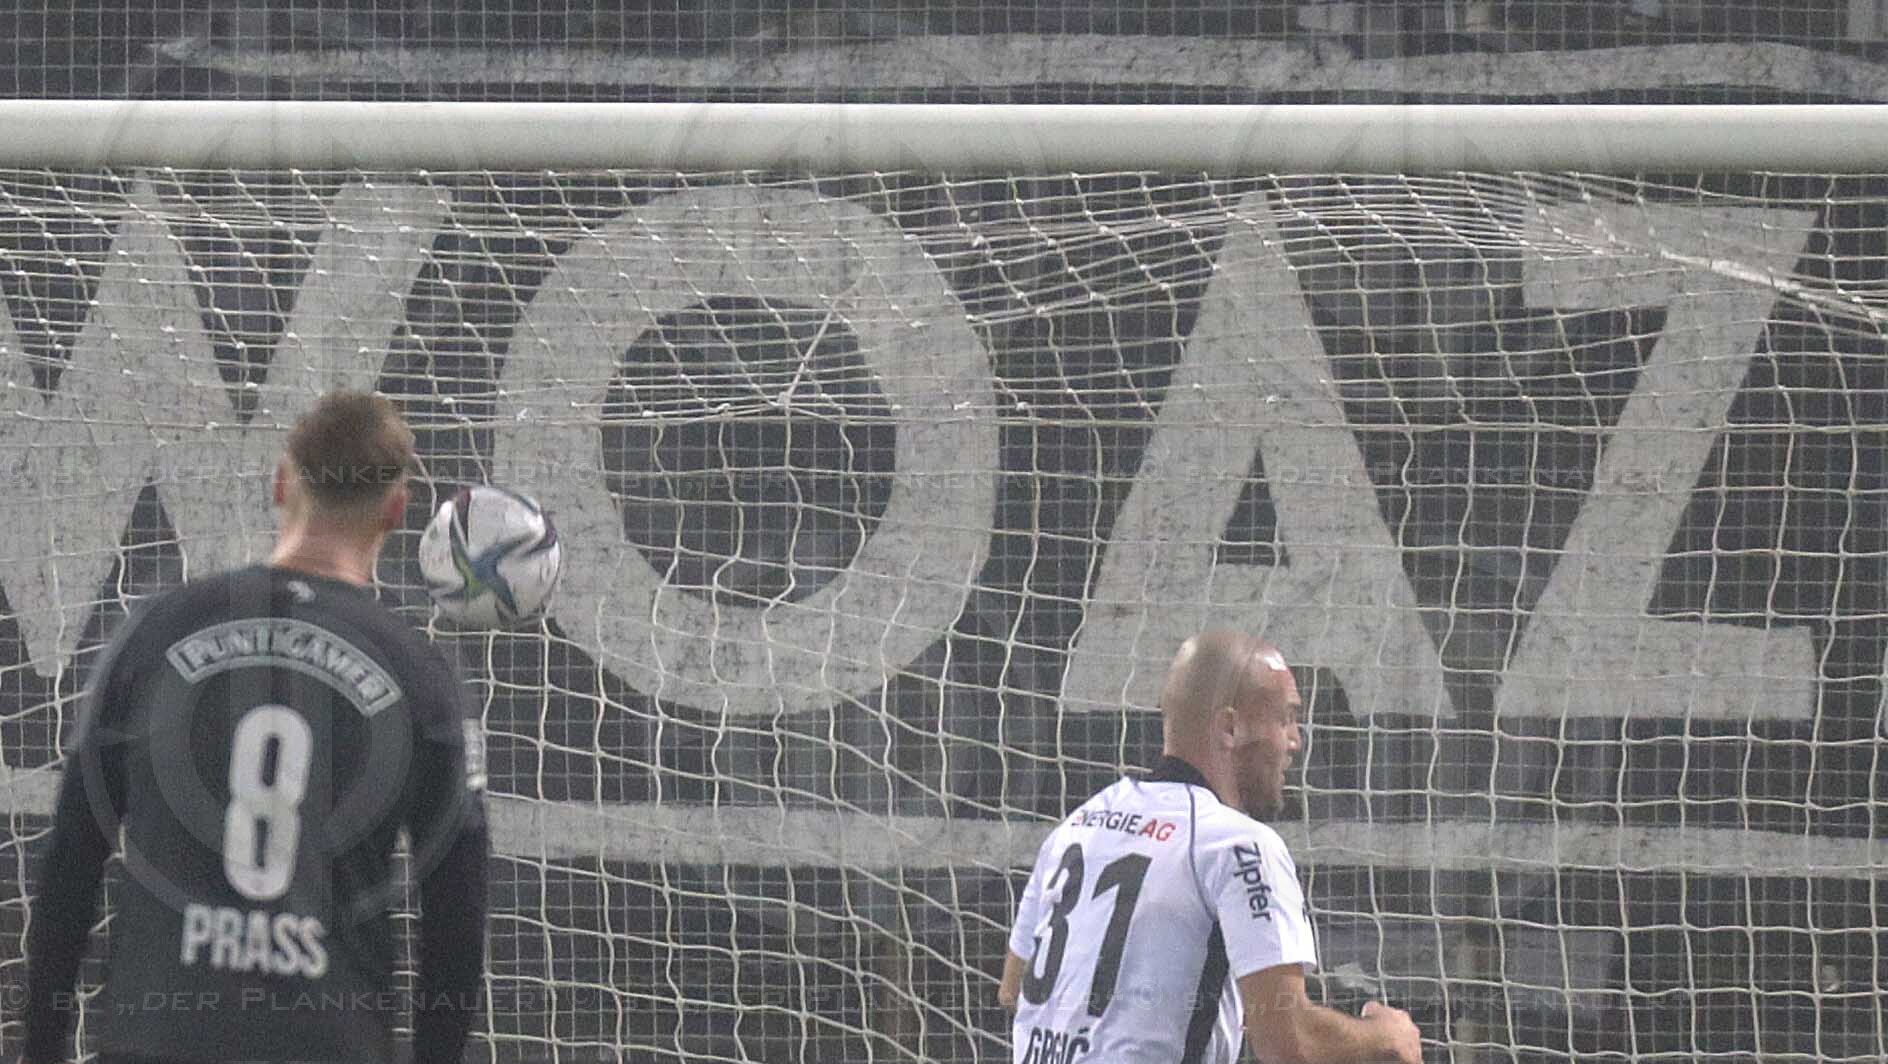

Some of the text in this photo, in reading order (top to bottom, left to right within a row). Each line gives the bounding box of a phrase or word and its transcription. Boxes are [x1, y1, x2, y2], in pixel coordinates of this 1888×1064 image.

[223, 704, 313, 900] 8
[180, 904, 329, 979] PRASS
[1020, 842, 1153, 1018] 31
[1233, 841, 1273, 923] Zipfer
